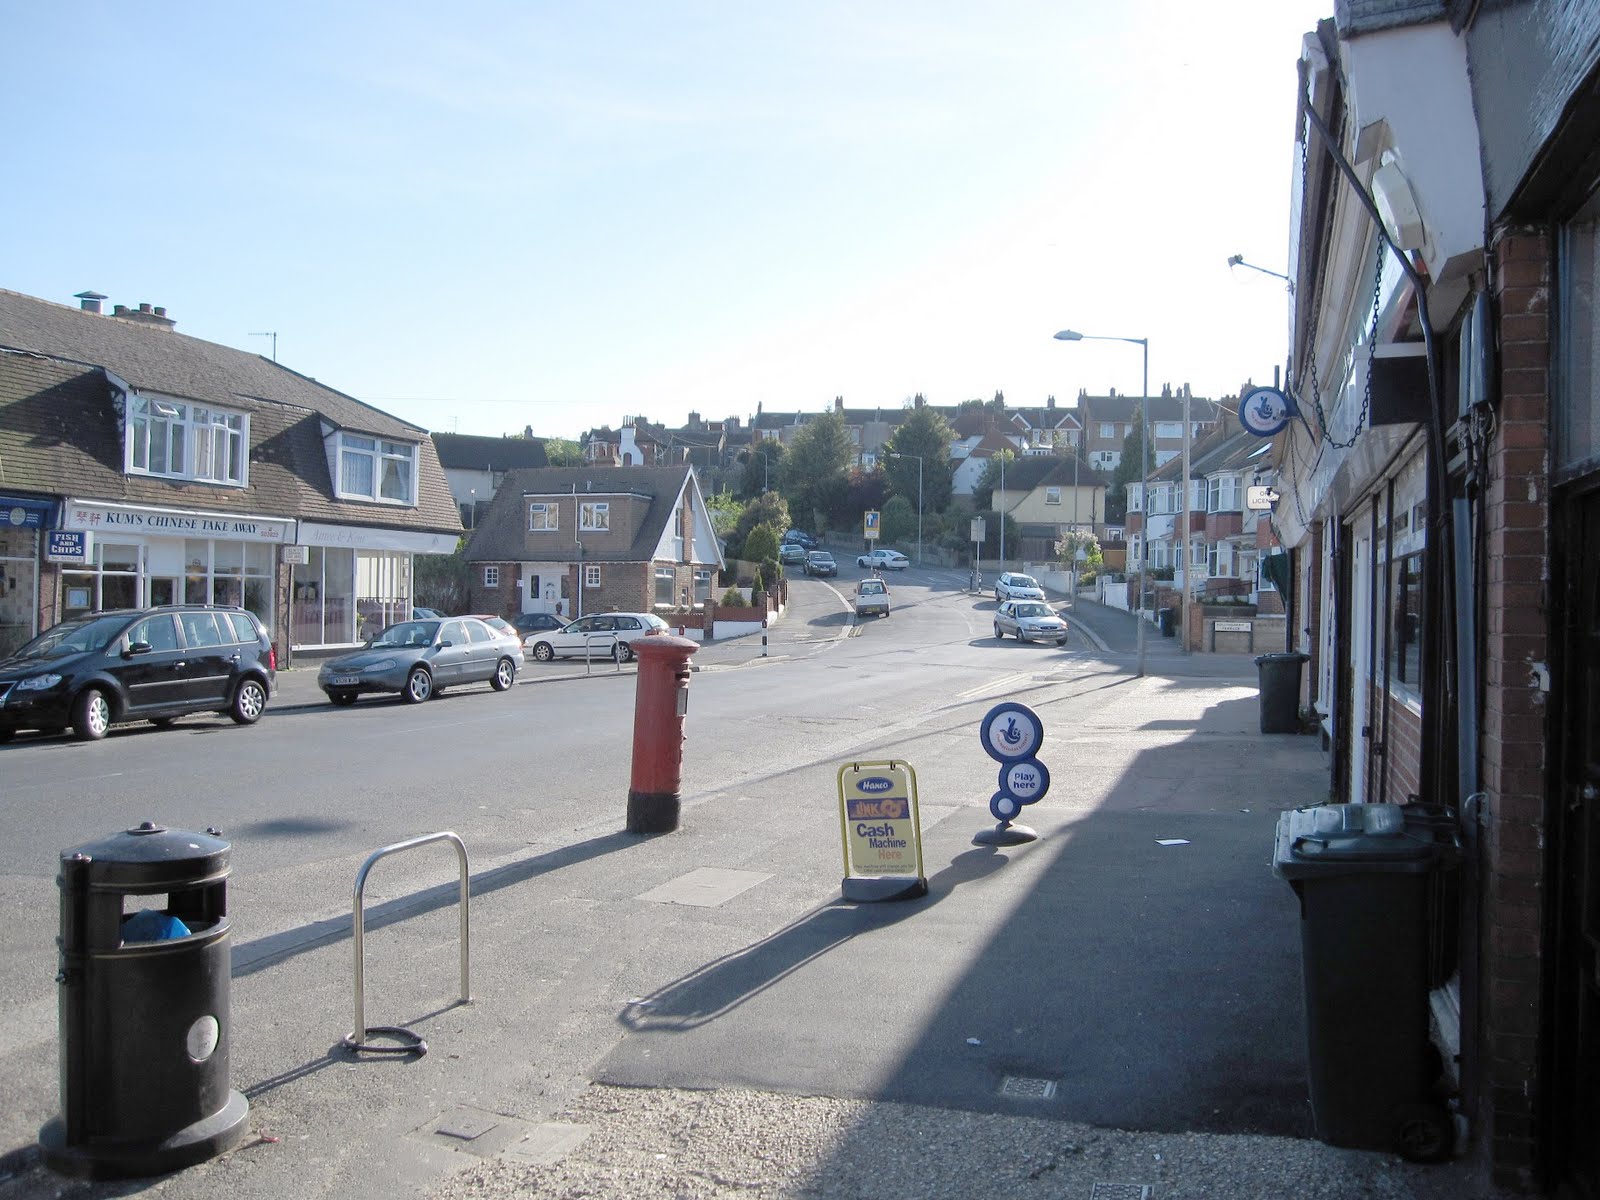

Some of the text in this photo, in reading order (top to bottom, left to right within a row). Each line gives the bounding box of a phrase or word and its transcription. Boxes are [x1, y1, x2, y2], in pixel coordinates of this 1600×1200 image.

[106, 512, 143, 525] KUM'S
[147, 515, 198, 530] CHINESE
[202, 519, 229, 531] TAKE
[232, 523, 258, 534] AWAY
[55, 533, 79, 542] FISH
[51, 544, 82, 554] CHIPS
[1014, 772, 1035, 781] Play
[857, 823, 894, 837] Cash
[869, 837, 907, 848] Machine
[878, 850, 902, 860] Here
